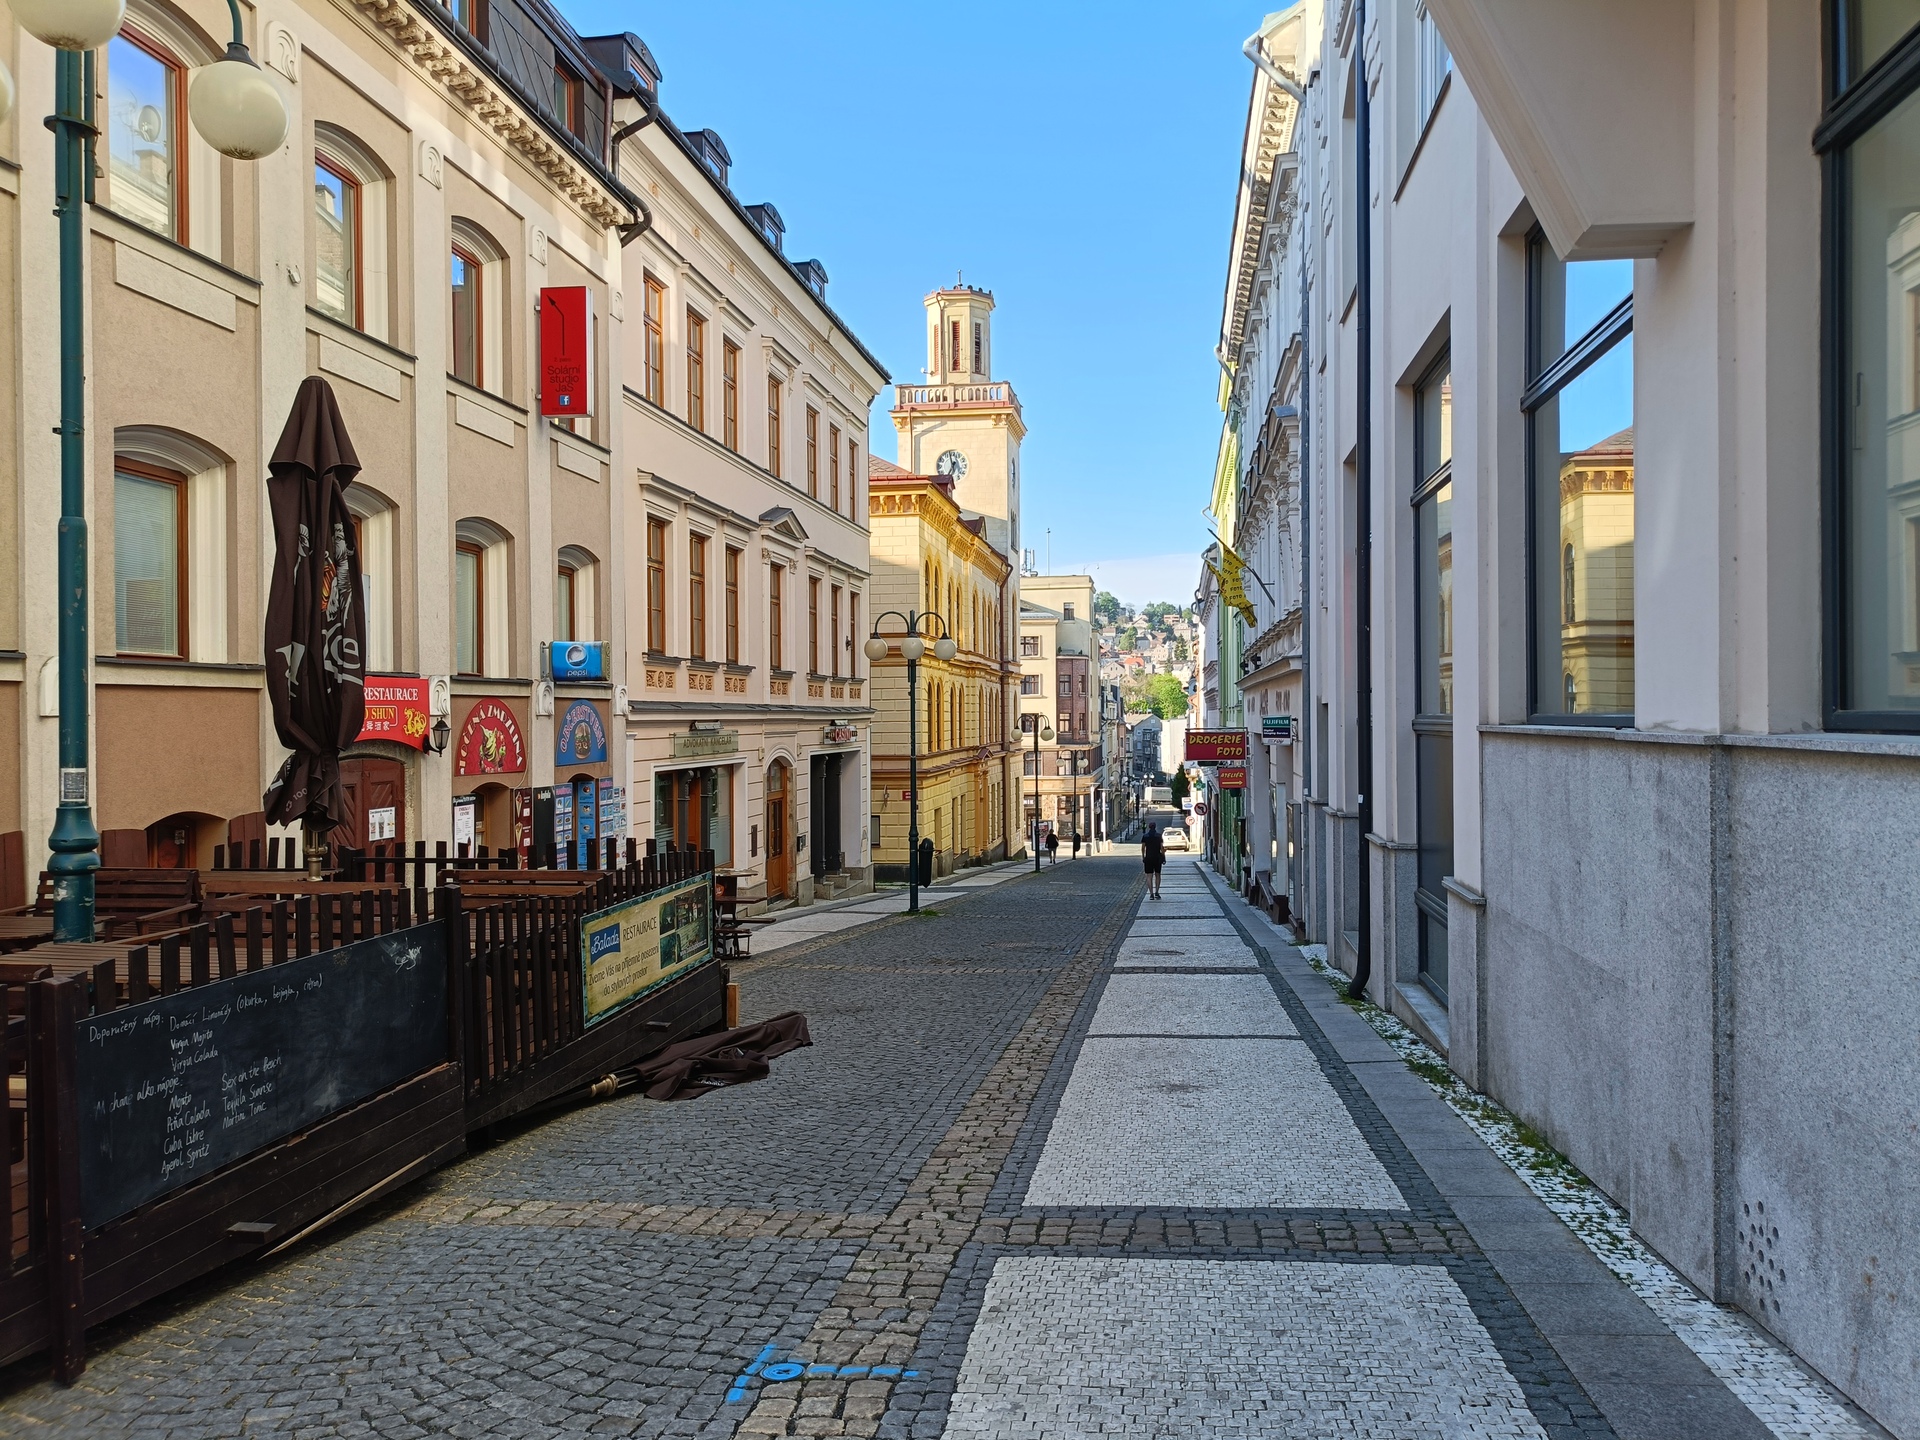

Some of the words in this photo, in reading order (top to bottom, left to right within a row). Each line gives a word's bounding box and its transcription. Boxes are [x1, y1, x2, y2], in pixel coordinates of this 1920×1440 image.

[547, 364, 581, 375] Solární
[550, 375, 580, 384] studio
[555, 383, 574, 392] JaS
[364, 687, 418, 700] RESTAURACE
[371, 708, 395, 720] SHUN
[1189, 735, 1242, 744] DROGERIE
[1217, 747, 1243, 756] FOTO
[591, 929, 619, 955] Balada
[622, 917, 657, 942] RESTAURACE
[589, 970, 605, 986] Zveme
[605, 964, 614, 978] Vás
[615, 964, 621, 973] na
[604, 984, 610, 996] do
[632, 966, 648, 984] prostor
[89, 1016, 138, 1046] Doporučený
[143, 1010, 164, 1026] nápoj:
[170, 1013, 197, 1032] Domácí
[170, 1038, 189, 1055] Virgin
[192, 1029, 213, 1047] Mojito
[171, 1057, 193, 1075] Virgin
[194, 1045, 218, 1063] Colada
[221, 1073, 237, 1092] Sex
[238, 1072, 247, 1083] on
[248, 1067, 260, 1079] the
[263, 1056, 282, 1072] Beach
[169, 1092, 192, 1115] Mojito
[222, 1088, 247, 1112] Tequila
[250, 1082, 273, 1100] Sunrise
[184, 1100, 211, 1126] Colada
[222, 1113, 246, 1130] Martini
[249, 1101, 267, 1116] Tonic
[164, 1137, 183, 1155] Cuba
[185, 1129, 204, 1146] Libre
[161, 1152, 184, 1181] Aperol
